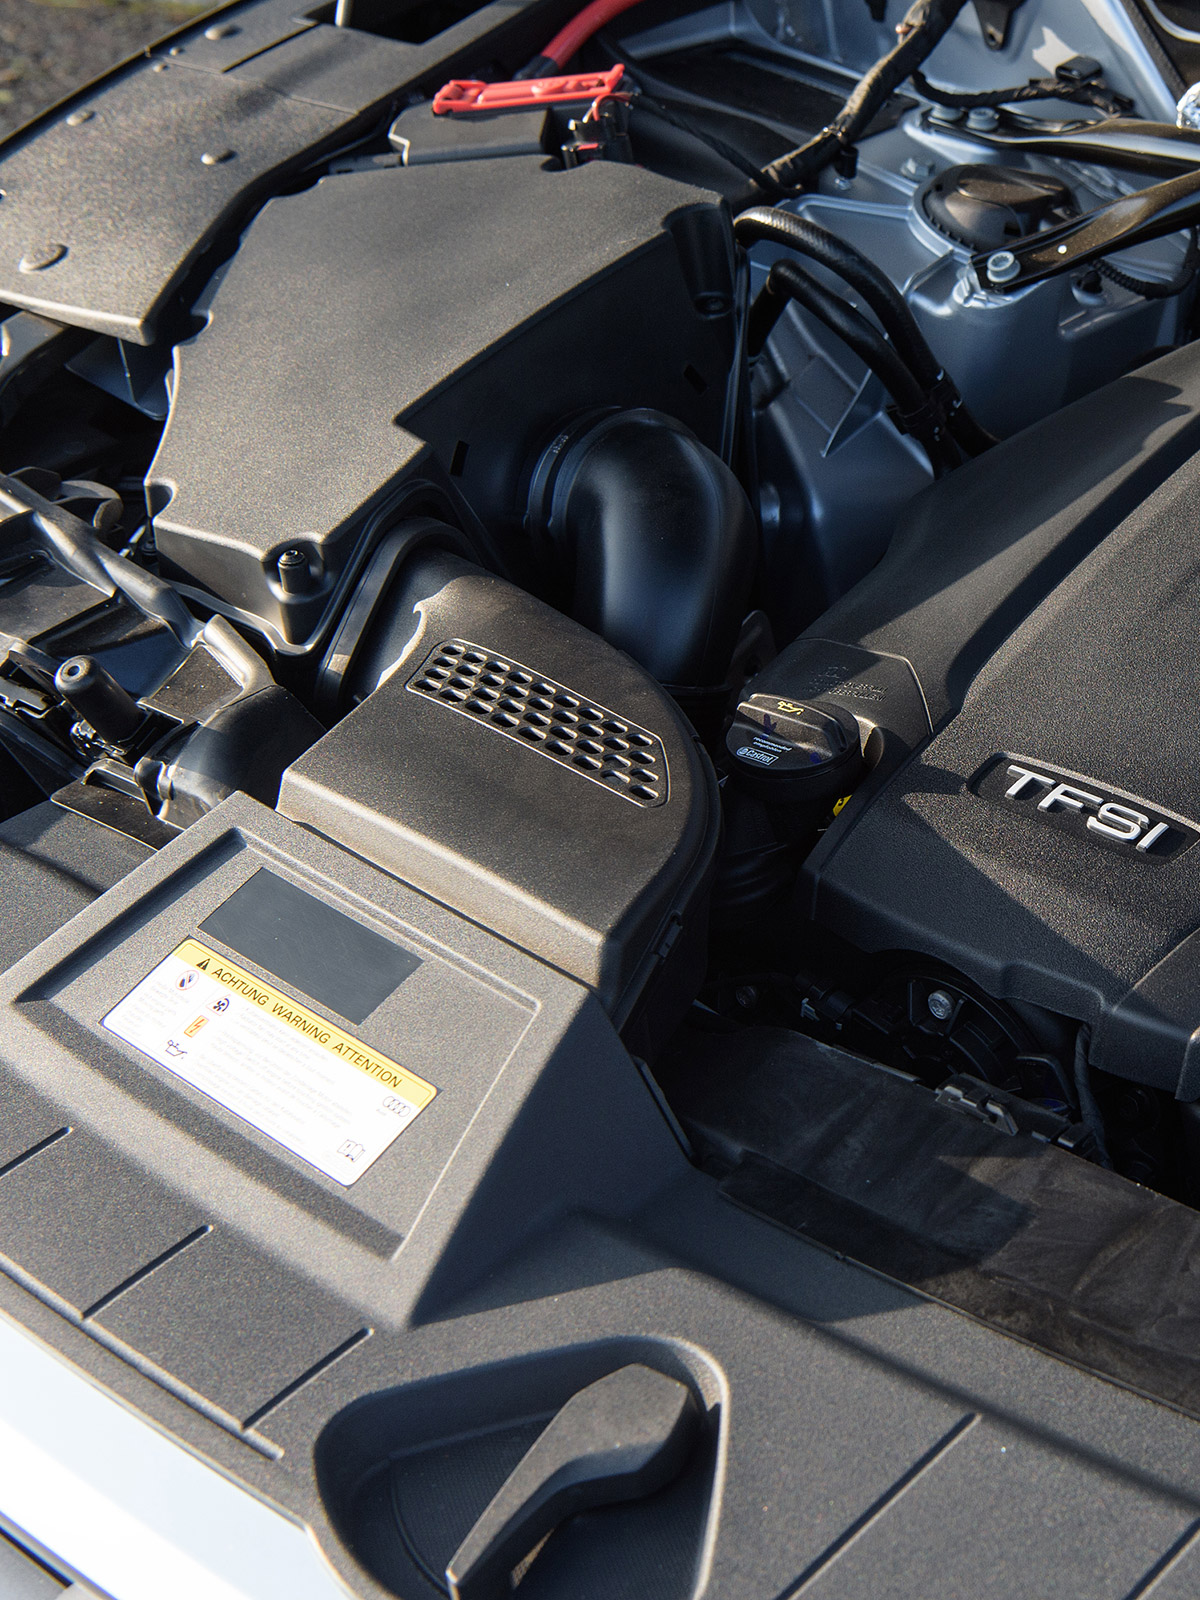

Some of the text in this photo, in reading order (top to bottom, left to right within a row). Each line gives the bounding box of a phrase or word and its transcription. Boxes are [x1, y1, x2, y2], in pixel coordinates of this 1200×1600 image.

[746, 750, 774, 763] Castrol
[1004, 764, 1170, 852] TFSI
[211, 967, 270, 1006] ACHTUNG
[271, 1002, 331, 1044] WARNING
[332, 1042, 402, 1088] ATTENTION
